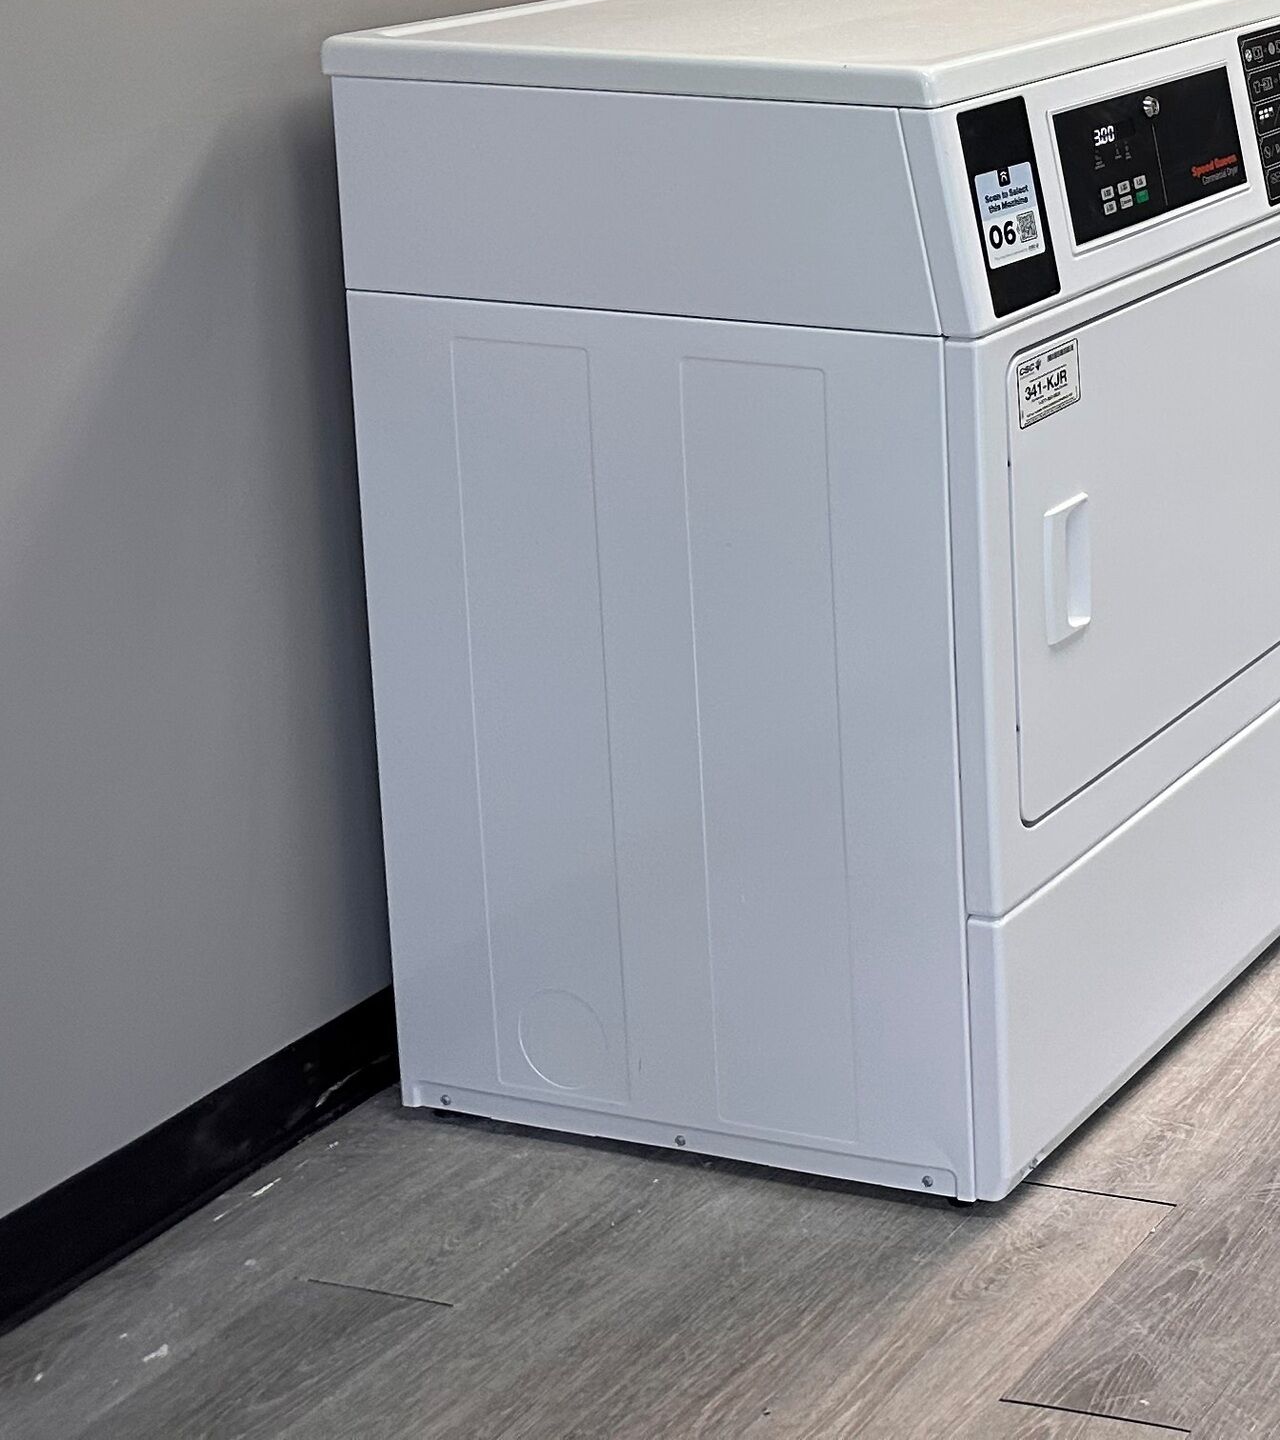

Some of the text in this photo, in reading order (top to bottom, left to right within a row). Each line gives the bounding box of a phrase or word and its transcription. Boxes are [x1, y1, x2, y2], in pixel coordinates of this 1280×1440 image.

[985, 184, 1029, 204] Scan to Select
[988, 196, 1029, 214] this Machine
[989, 220, 1016, 249] 06
[1020, 363, 1035, 376] CSC
[1025, 369, 1067, 401] 341-KJR
